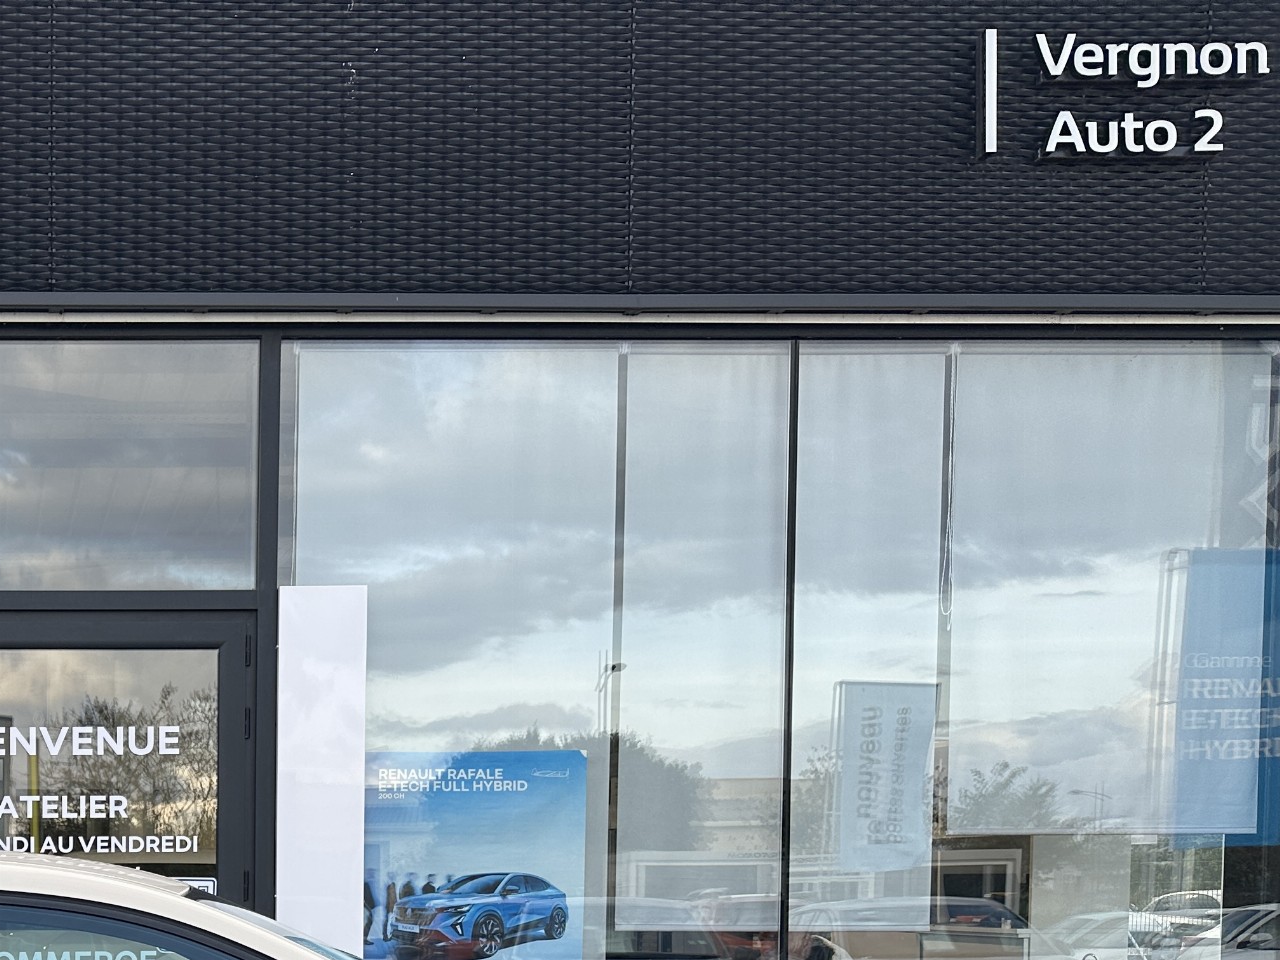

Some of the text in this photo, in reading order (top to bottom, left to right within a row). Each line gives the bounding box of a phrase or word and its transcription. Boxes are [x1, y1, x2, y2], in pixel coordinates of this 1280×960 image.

[1035, 33, 1270, 88] Vergnon
[1045, 108, 1224, 153] Auto 2
[378, 768, 503, 780] RENAULT RAFALE
[378, 780, 528, 792] E-TECH FULL HYBRID
[40, 835, 75, 853] AU
[78, 835, 198, 853] VENDREDI
